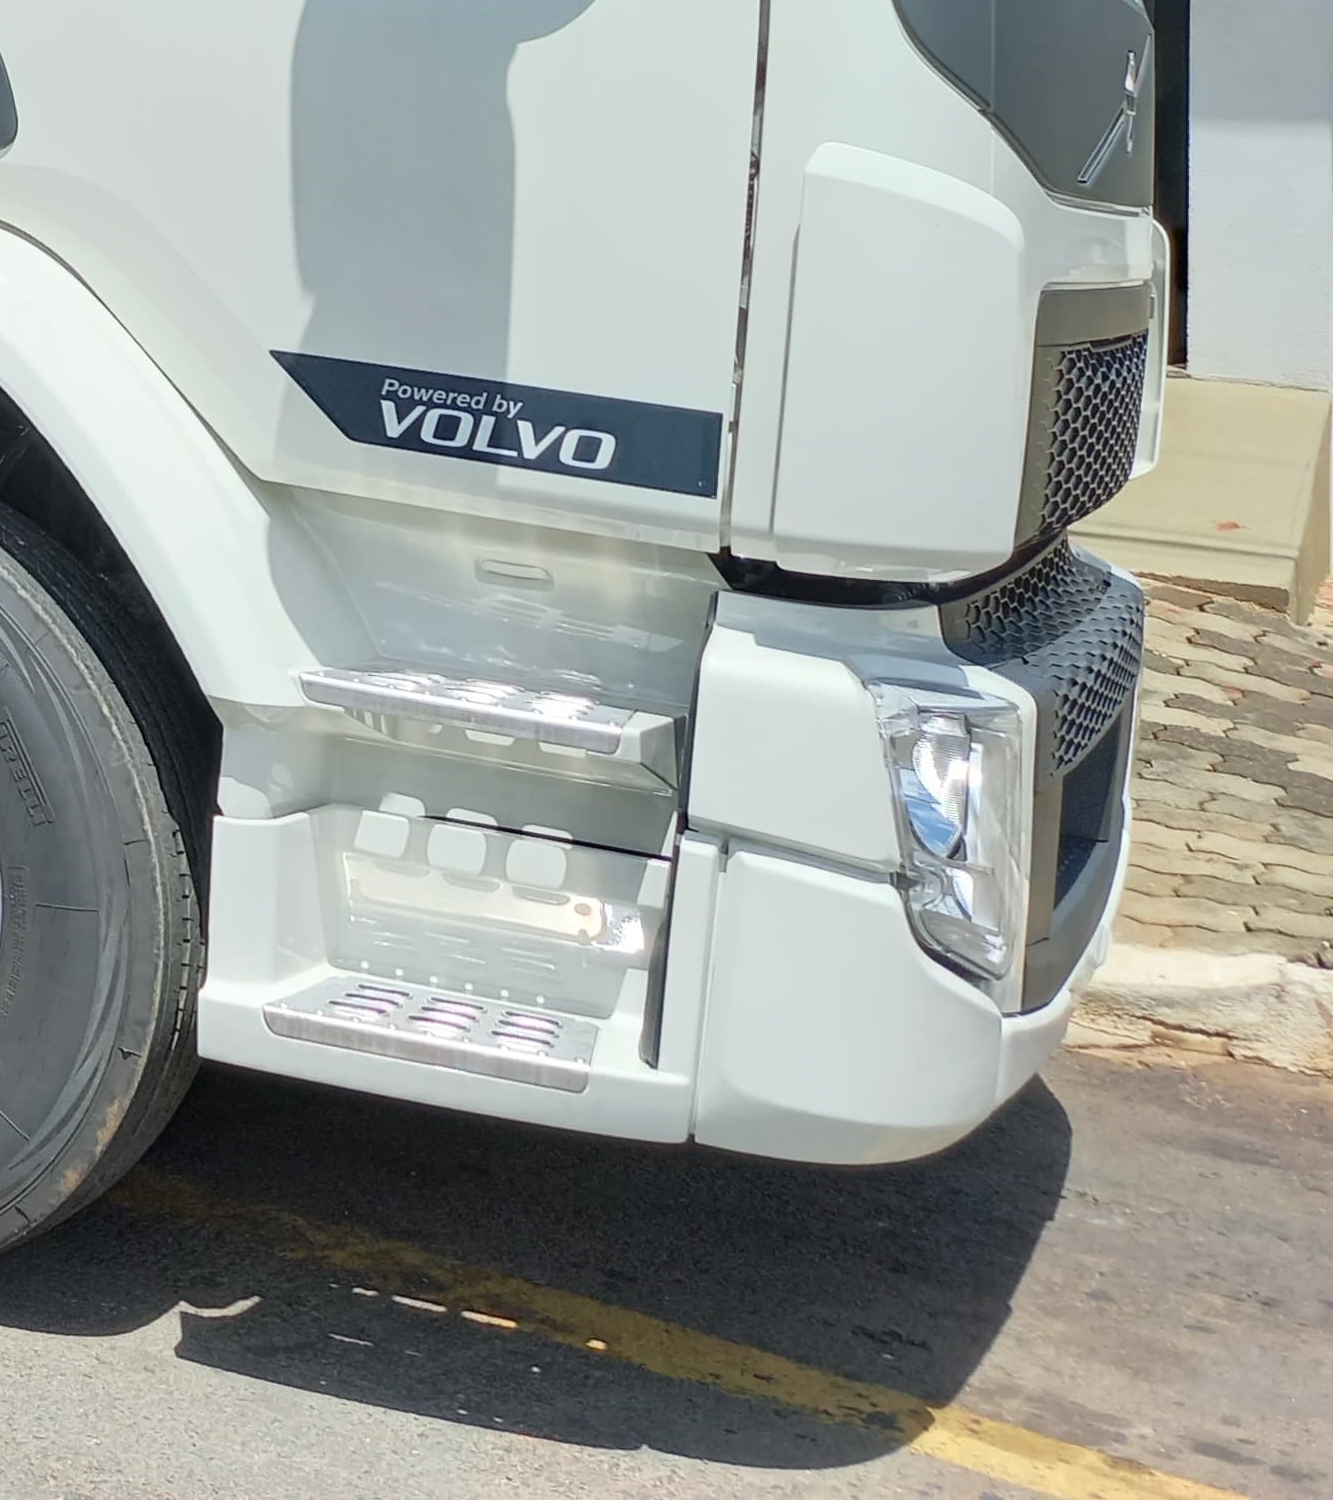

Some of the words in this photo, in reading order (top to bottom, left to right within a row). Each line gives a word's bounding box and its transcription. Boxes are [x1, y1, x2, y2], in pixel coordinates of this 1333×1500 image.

[380, 378, 487, 410] Powered
[493, 393, 523, 419] by
[380, 399, 617, 471] VOLVO
